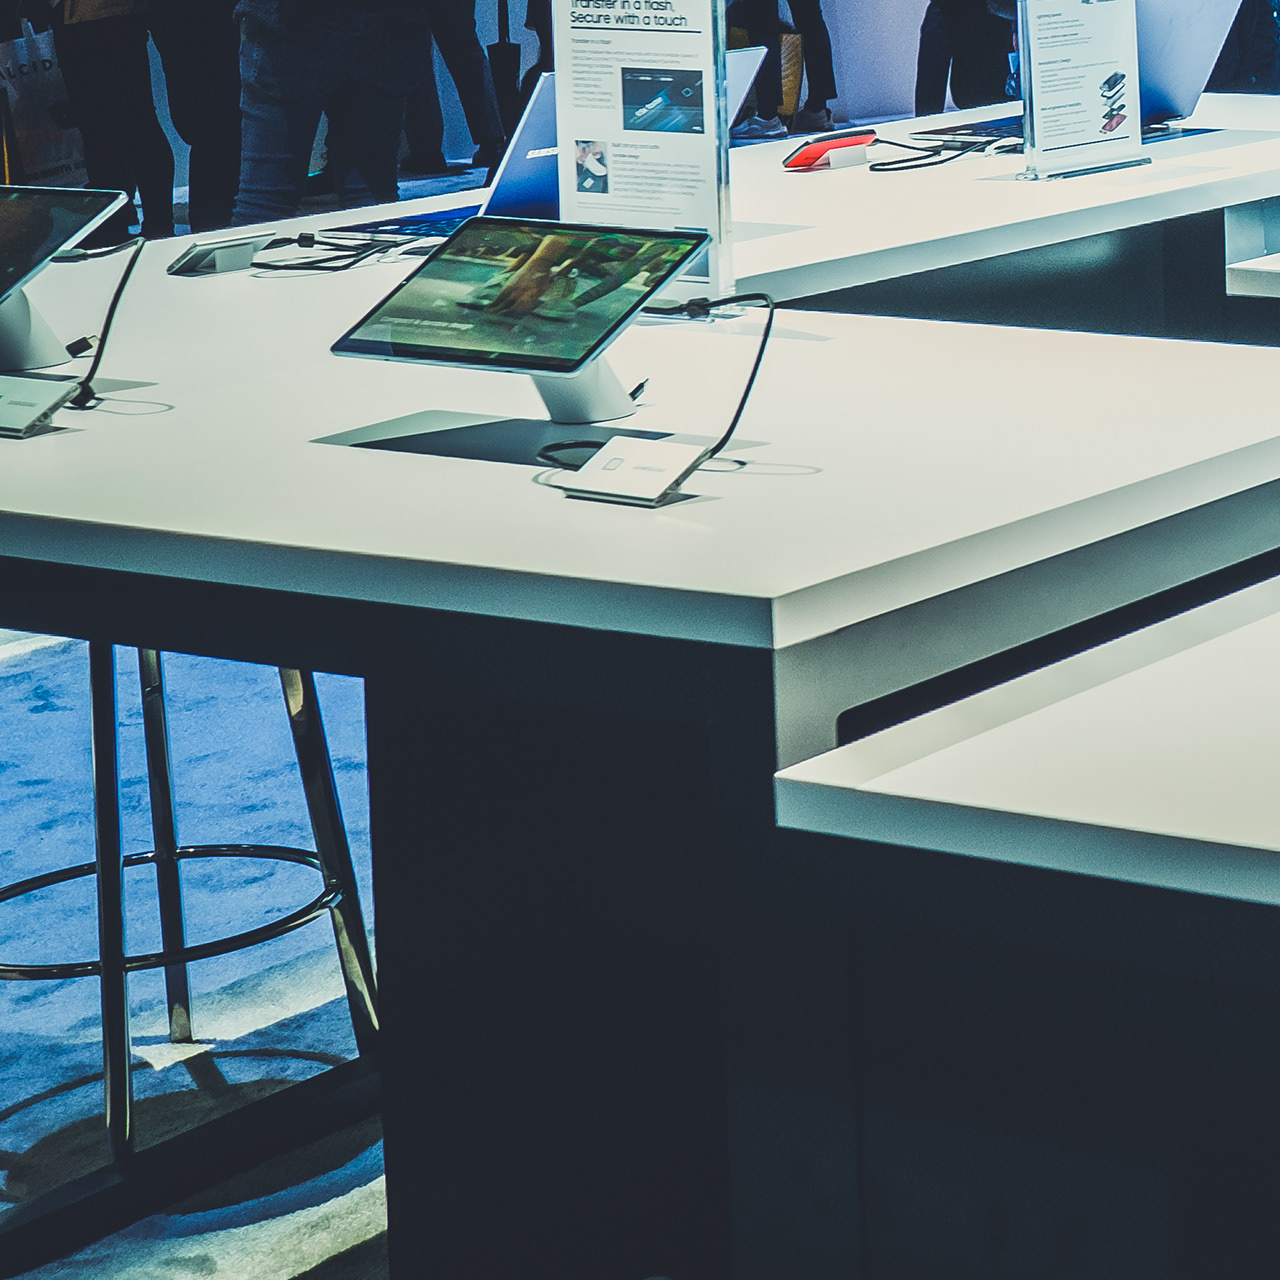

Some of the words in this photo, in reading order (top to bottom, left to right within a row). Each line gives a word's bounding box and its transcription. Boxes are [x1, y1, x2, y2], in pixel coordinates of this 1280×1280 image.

[633, 0, 641, 10] a
[569, 11, 611, 24] Secure
[613, 12, 640, 25] with
[642, 15, 651, 26] a
[653, 15, 688, 27] touch
